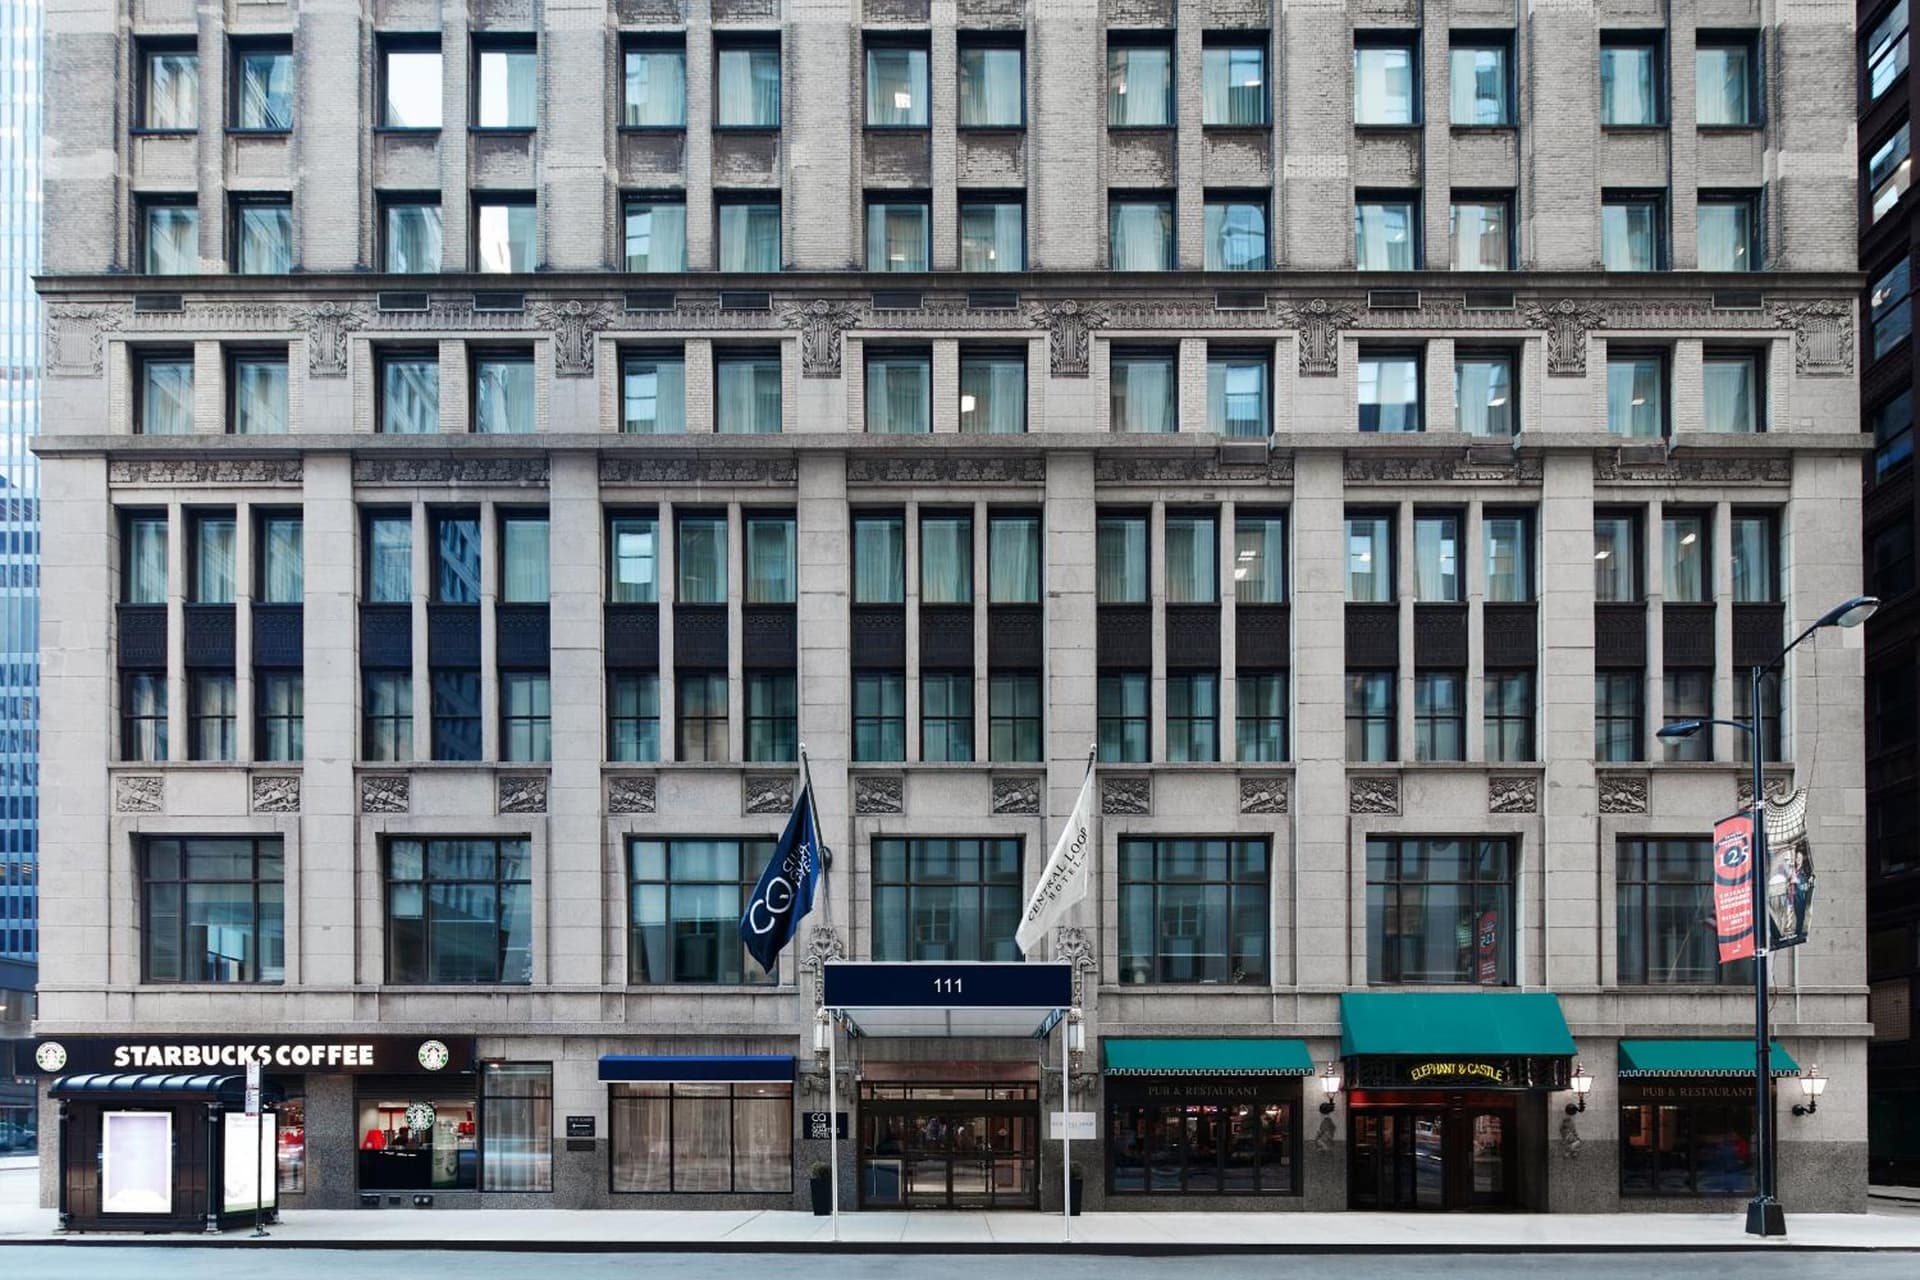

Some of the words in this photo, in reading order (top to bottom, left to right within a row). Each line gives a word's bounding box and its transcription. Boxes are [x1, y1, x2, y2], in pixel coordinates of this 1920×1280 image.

[1028, 864, 1067, 921] CENTRAL
[1064, 827, 1088, 862] LOOP
[1048, 860, 1081, 901] HOTEL
[933, 978, 962, 993] 111
[114, 1045, 272, 1066] STARBUCKS
[275, 1045, 374, 1066] COFFEE
[1411, 1063, 1456, 1081] ELEPHANT
[1458, 1063, 1467, 1075] &
[1467, 1063, 1504, 1081] CASTLE
[1147, 1086, 1170, 1097] PUB
[1184, 1086, 1258, 1097] RESTAURANT
[1642, 1087, 1665, 1097] PUB
[1679, 1087, 1754, 1097] RESTAURANT
